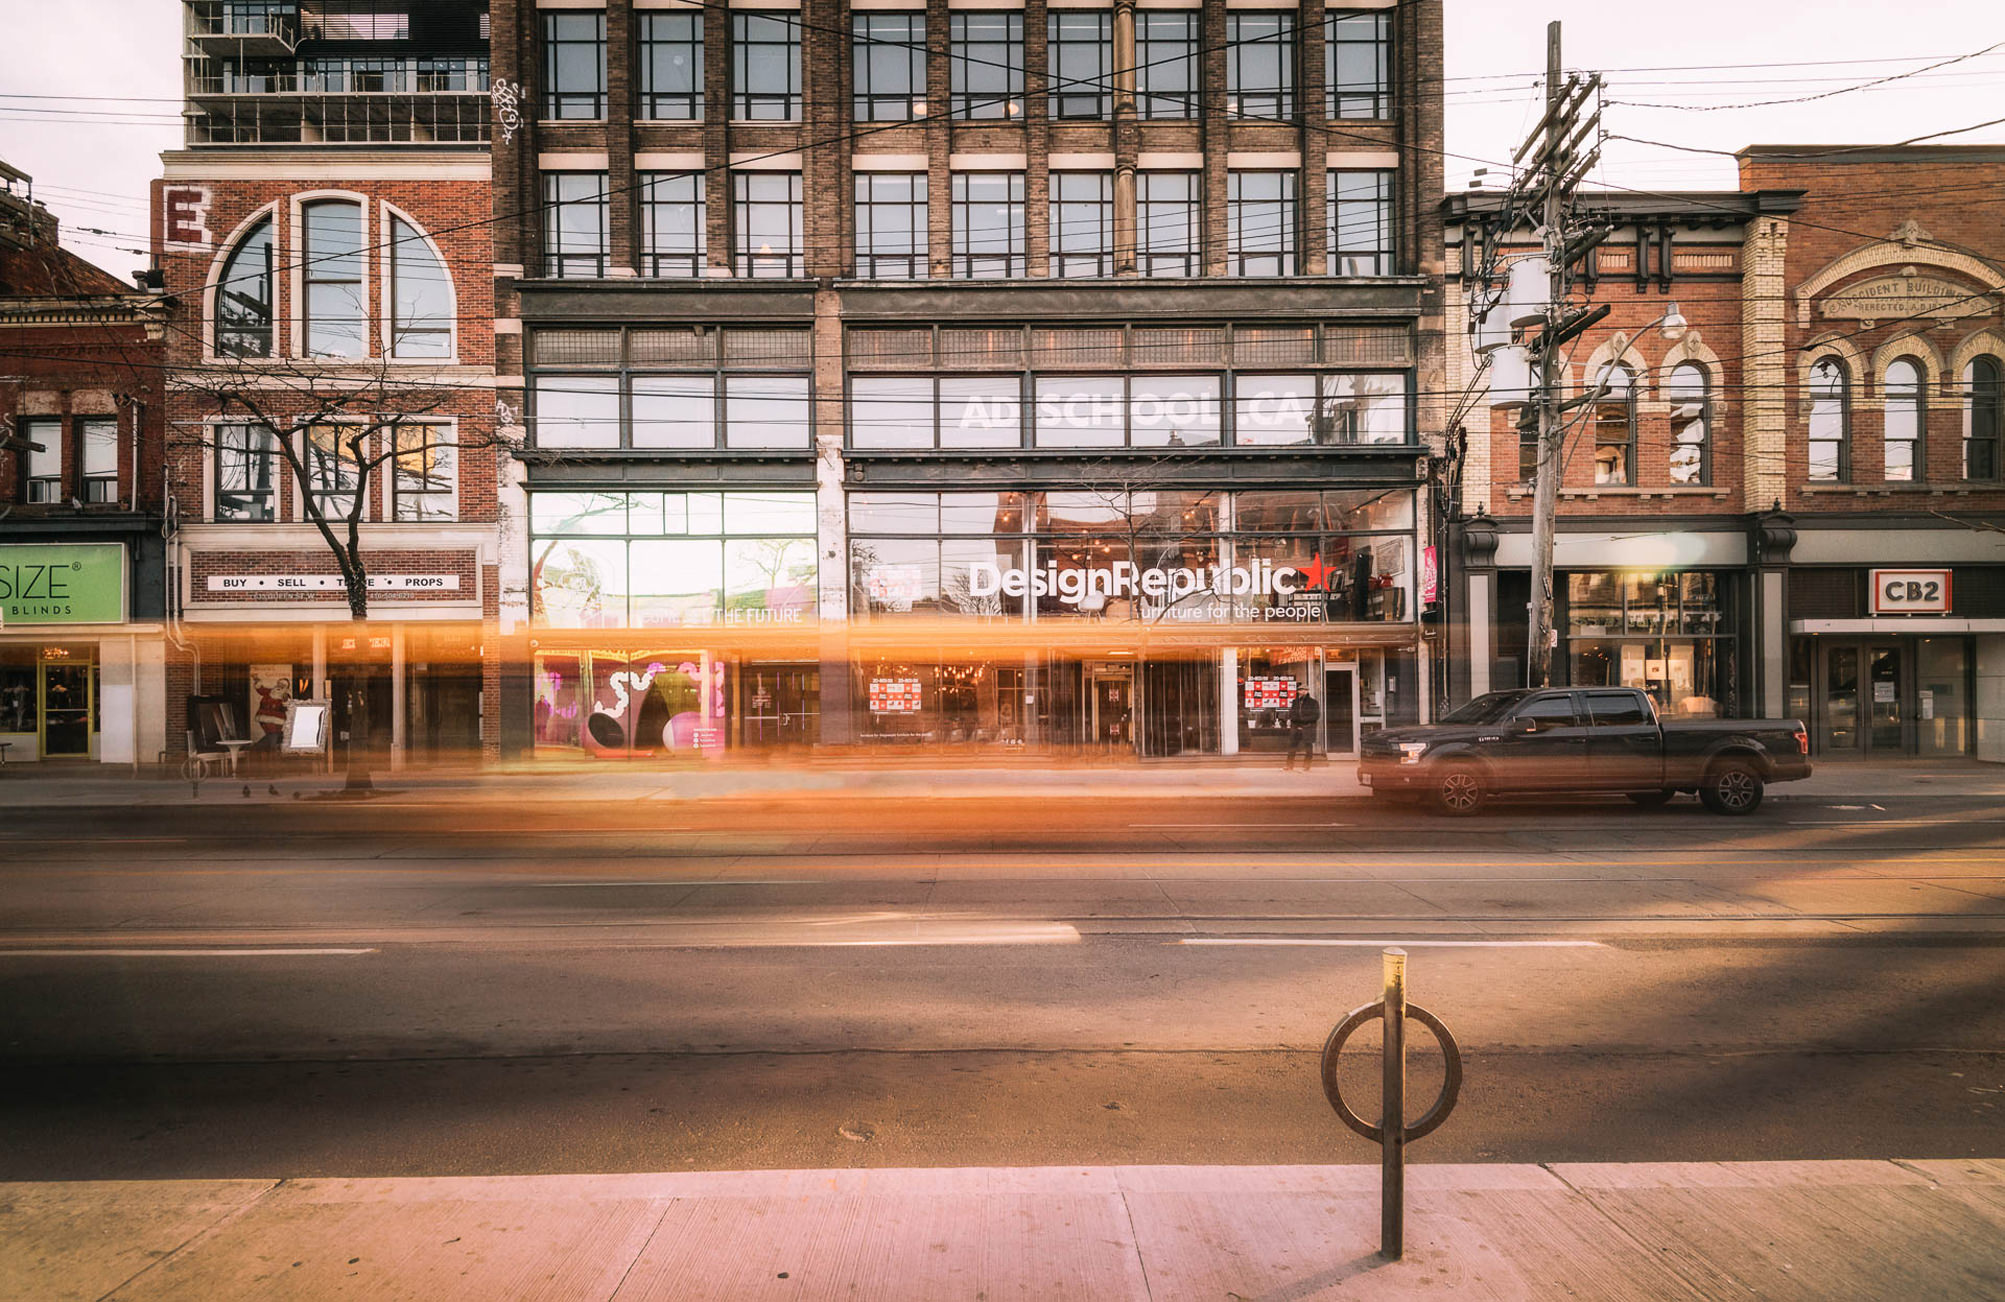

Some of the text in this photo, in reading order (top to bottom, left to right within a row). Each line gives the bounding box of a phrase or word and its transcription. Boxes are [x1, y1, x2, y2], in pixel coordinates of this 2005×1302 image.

[165, 188, 205, 244] E
[223, 578, 444, 587] BUY SELL PROPS
[968, 557, 1298, 605] DesignRepublic
[1885, 581, 1939, 602] CB2
[12, 606, 72, 615] BLINDS
[714, 608, 745, 624] THE
[748, 607, 804, 624] FUTURE
[1207, 601, 1231, 619] for
[1234, 602, 1260, 619] the
[1264, 602, 1321, 622] people
